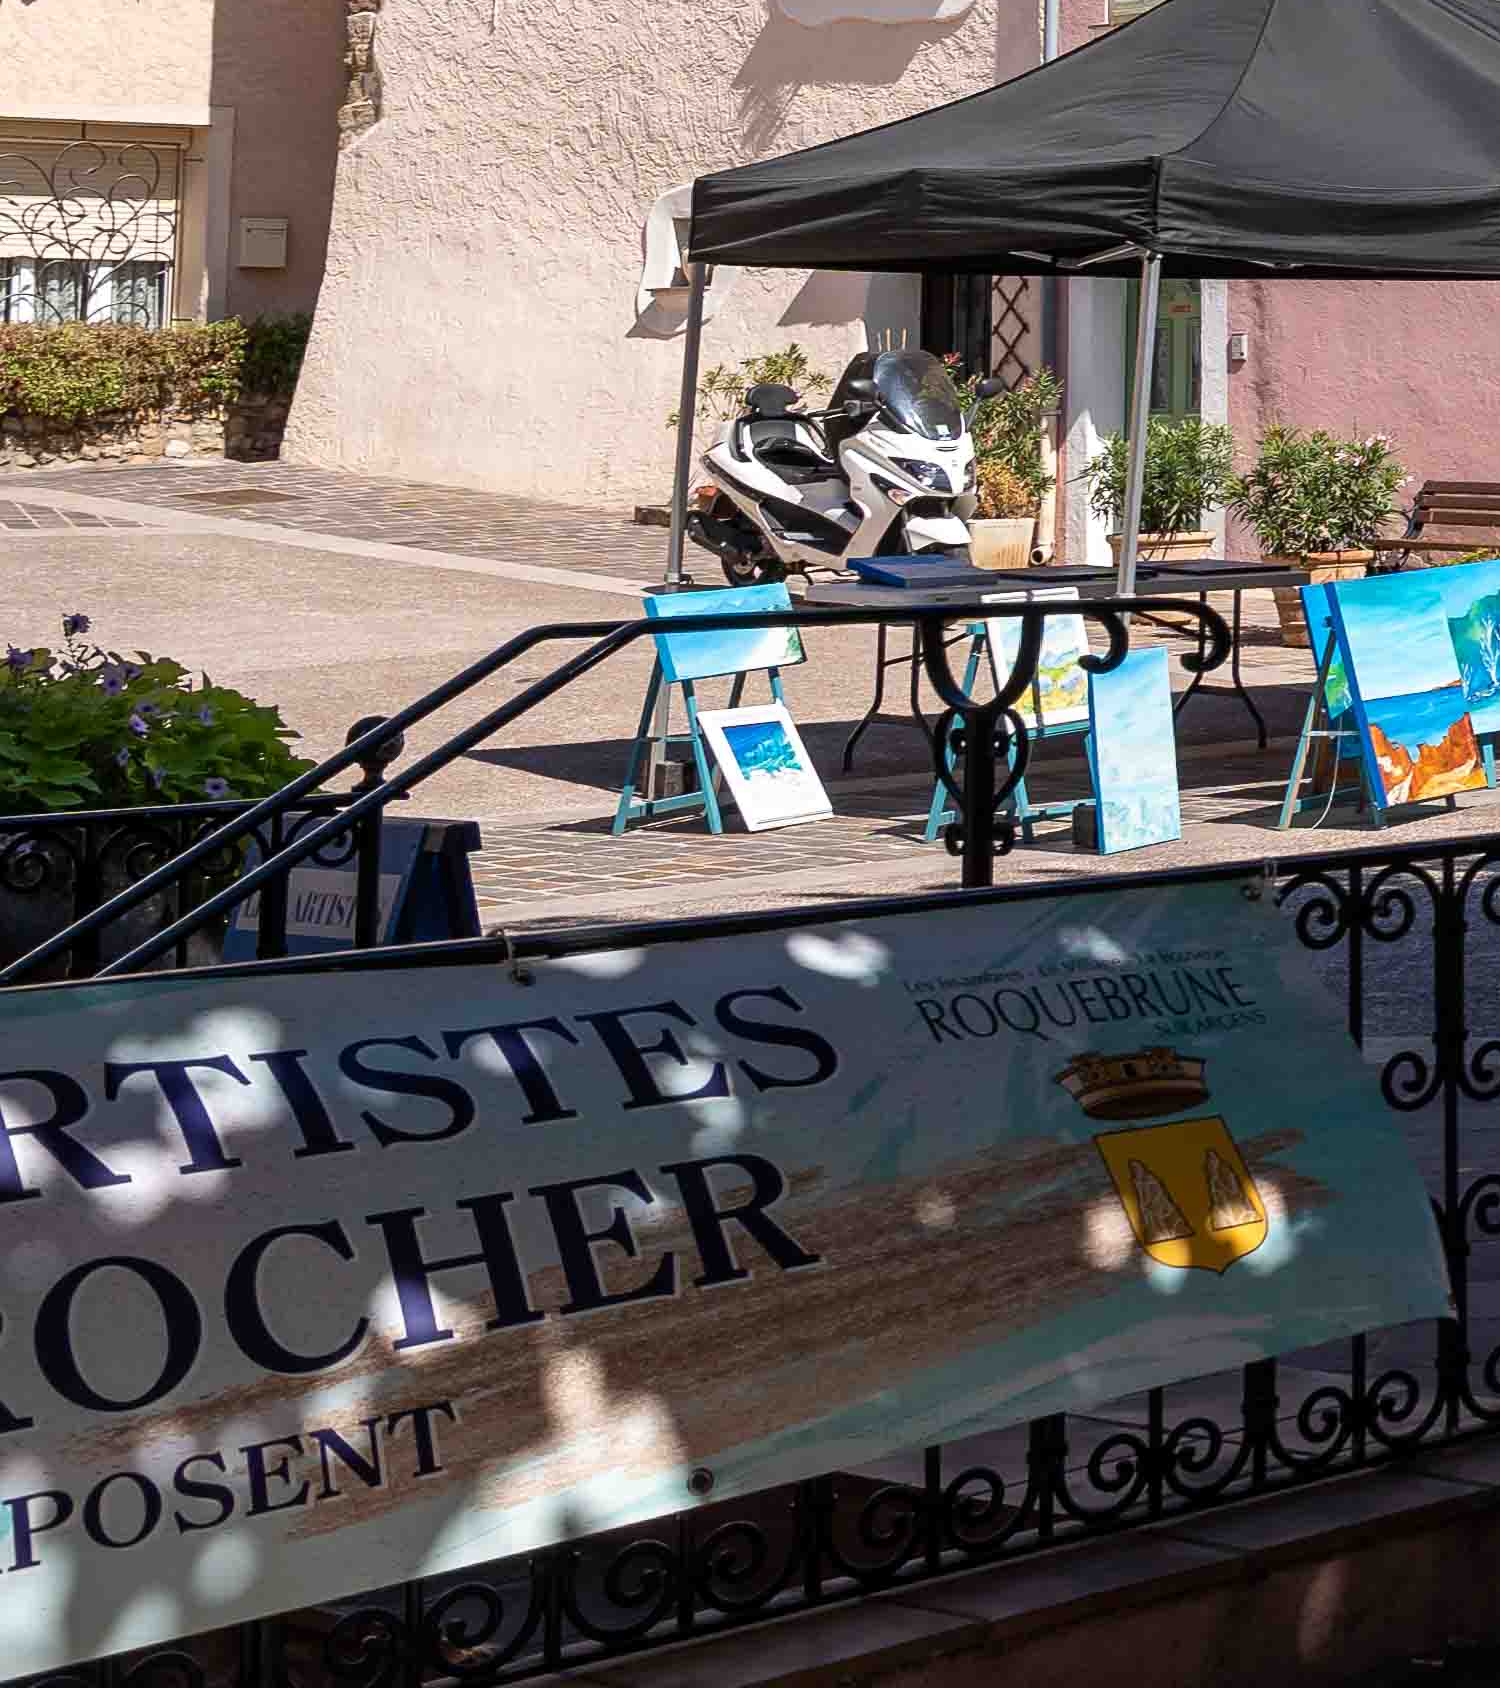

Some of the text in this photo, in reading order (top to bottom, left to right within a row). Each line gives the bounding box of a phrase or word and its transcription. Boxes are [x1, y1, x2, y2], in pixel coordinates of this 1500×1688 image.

[914, 966, 1257, 1044] ROQUEBRUNE
[0, 1152, 822, 1434] OCHER
[0, 1399, 457, 1573] POSENT
